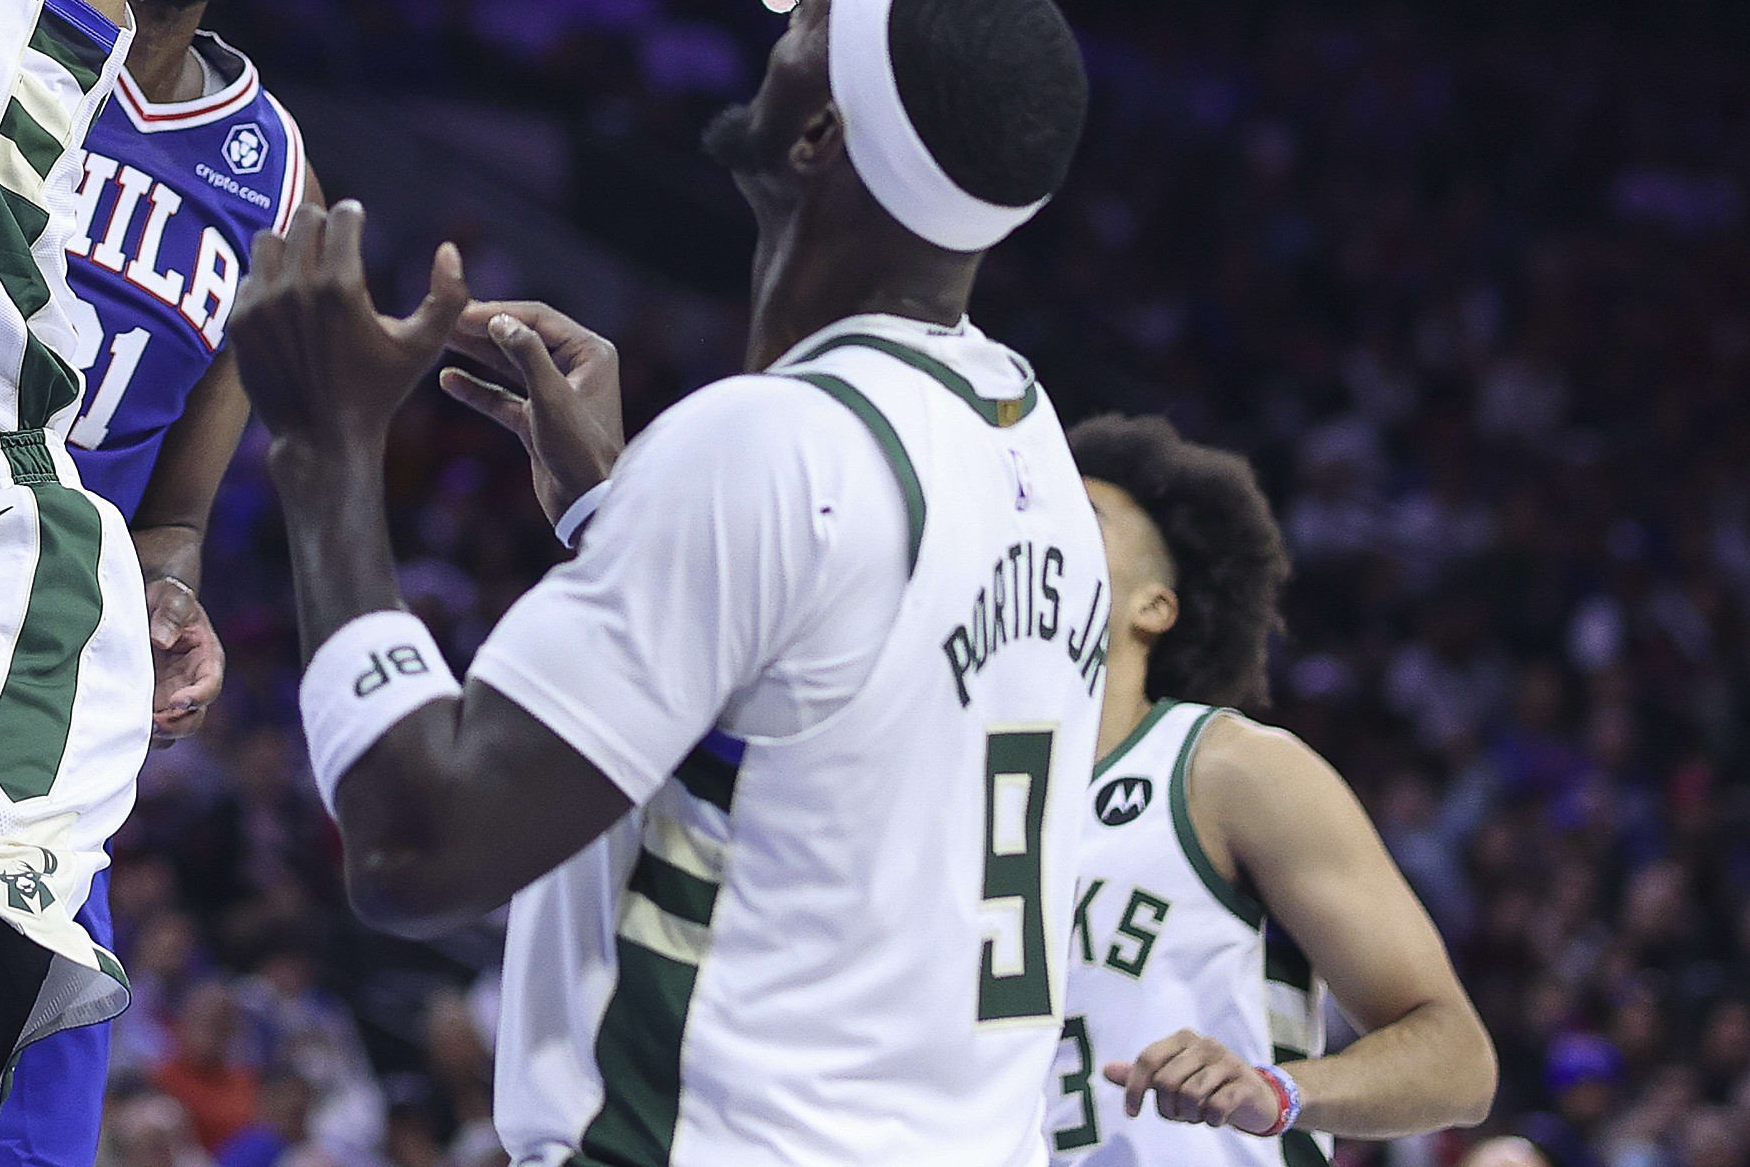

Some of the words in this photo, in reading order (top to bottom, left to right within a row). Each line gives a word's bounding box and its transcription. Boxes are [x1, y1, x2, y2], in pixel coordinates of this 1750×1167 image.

[65, 148, 240, 353] HILA
[195, 163, 272, 210] crypto.com
[352, 644, 430, 698] BP
[941, 540, 1065, 709] PORTIS
[975, 725, 1061, 1027] 9
